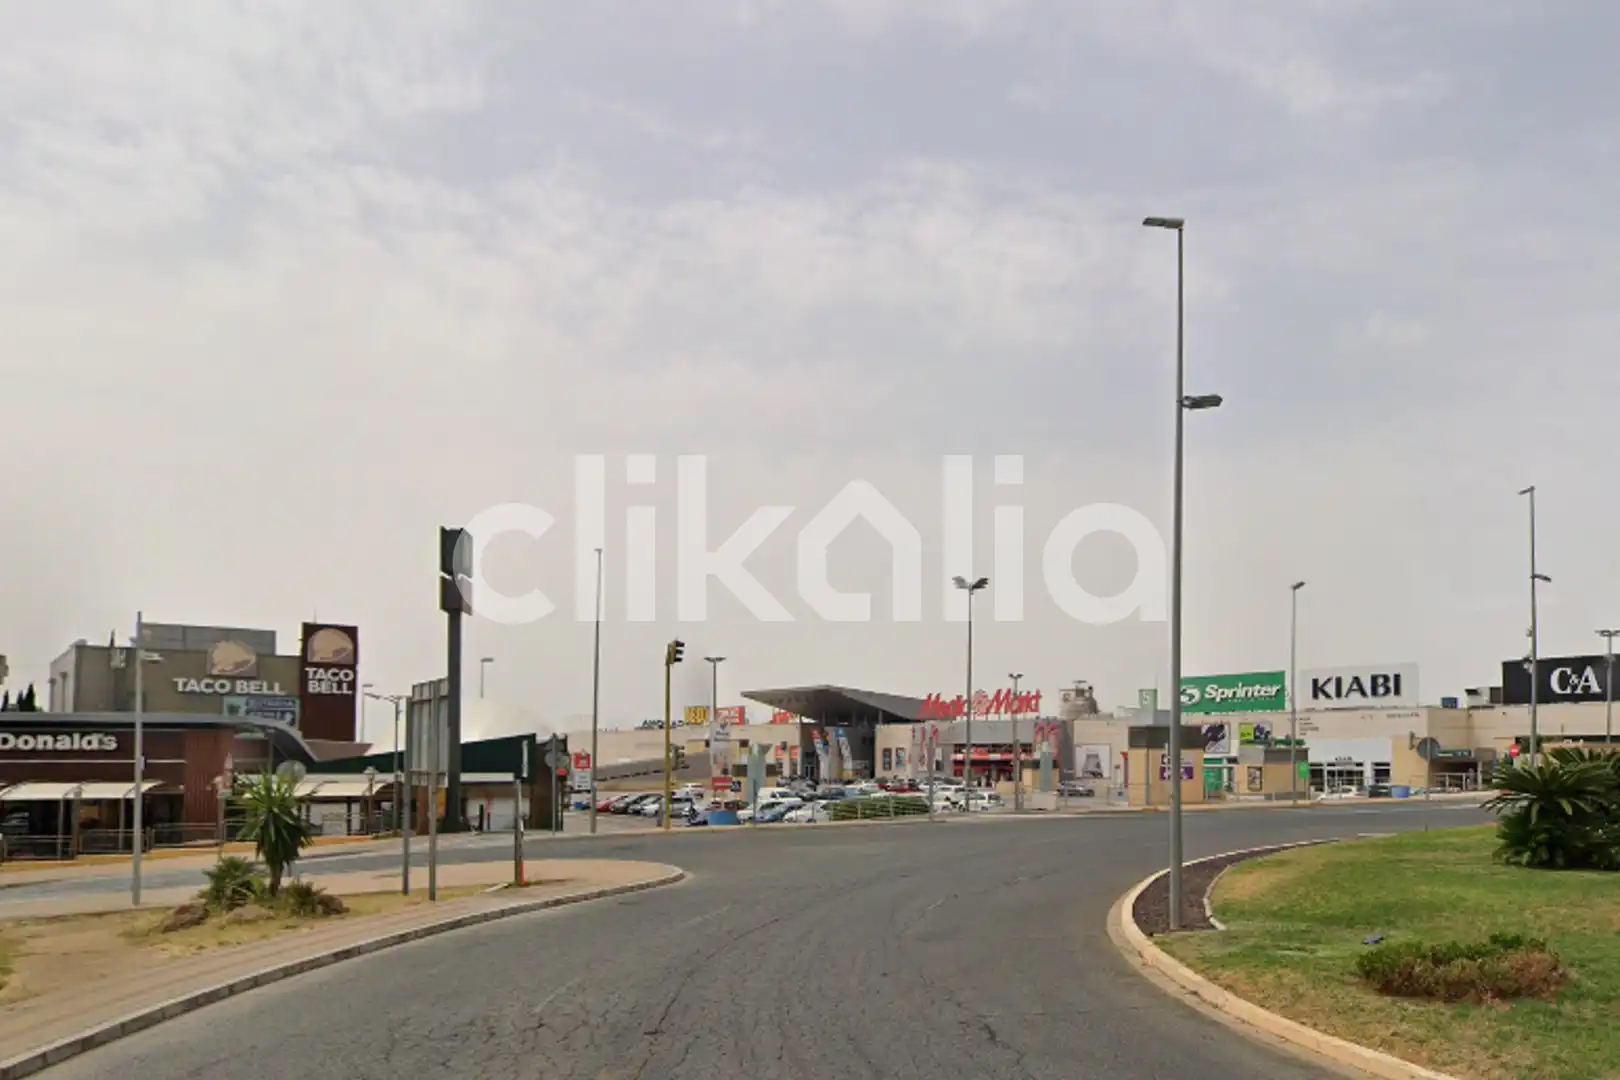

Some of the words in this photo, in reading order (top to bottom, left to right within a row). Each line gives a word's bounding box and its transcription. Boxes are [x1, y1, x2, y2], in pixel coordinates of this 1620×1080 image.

[305, 667, 354, 682] TACO
[1550, 665, 1602, 694] C&A
[173, 677, 231, 694] TACO
[235, 680, 286, 695] BELL
[308, 681, 353, 694] BELL
[1204, 681, 1282, 703] Sprinter
[1311, 673, 1402, 700] KIABI
